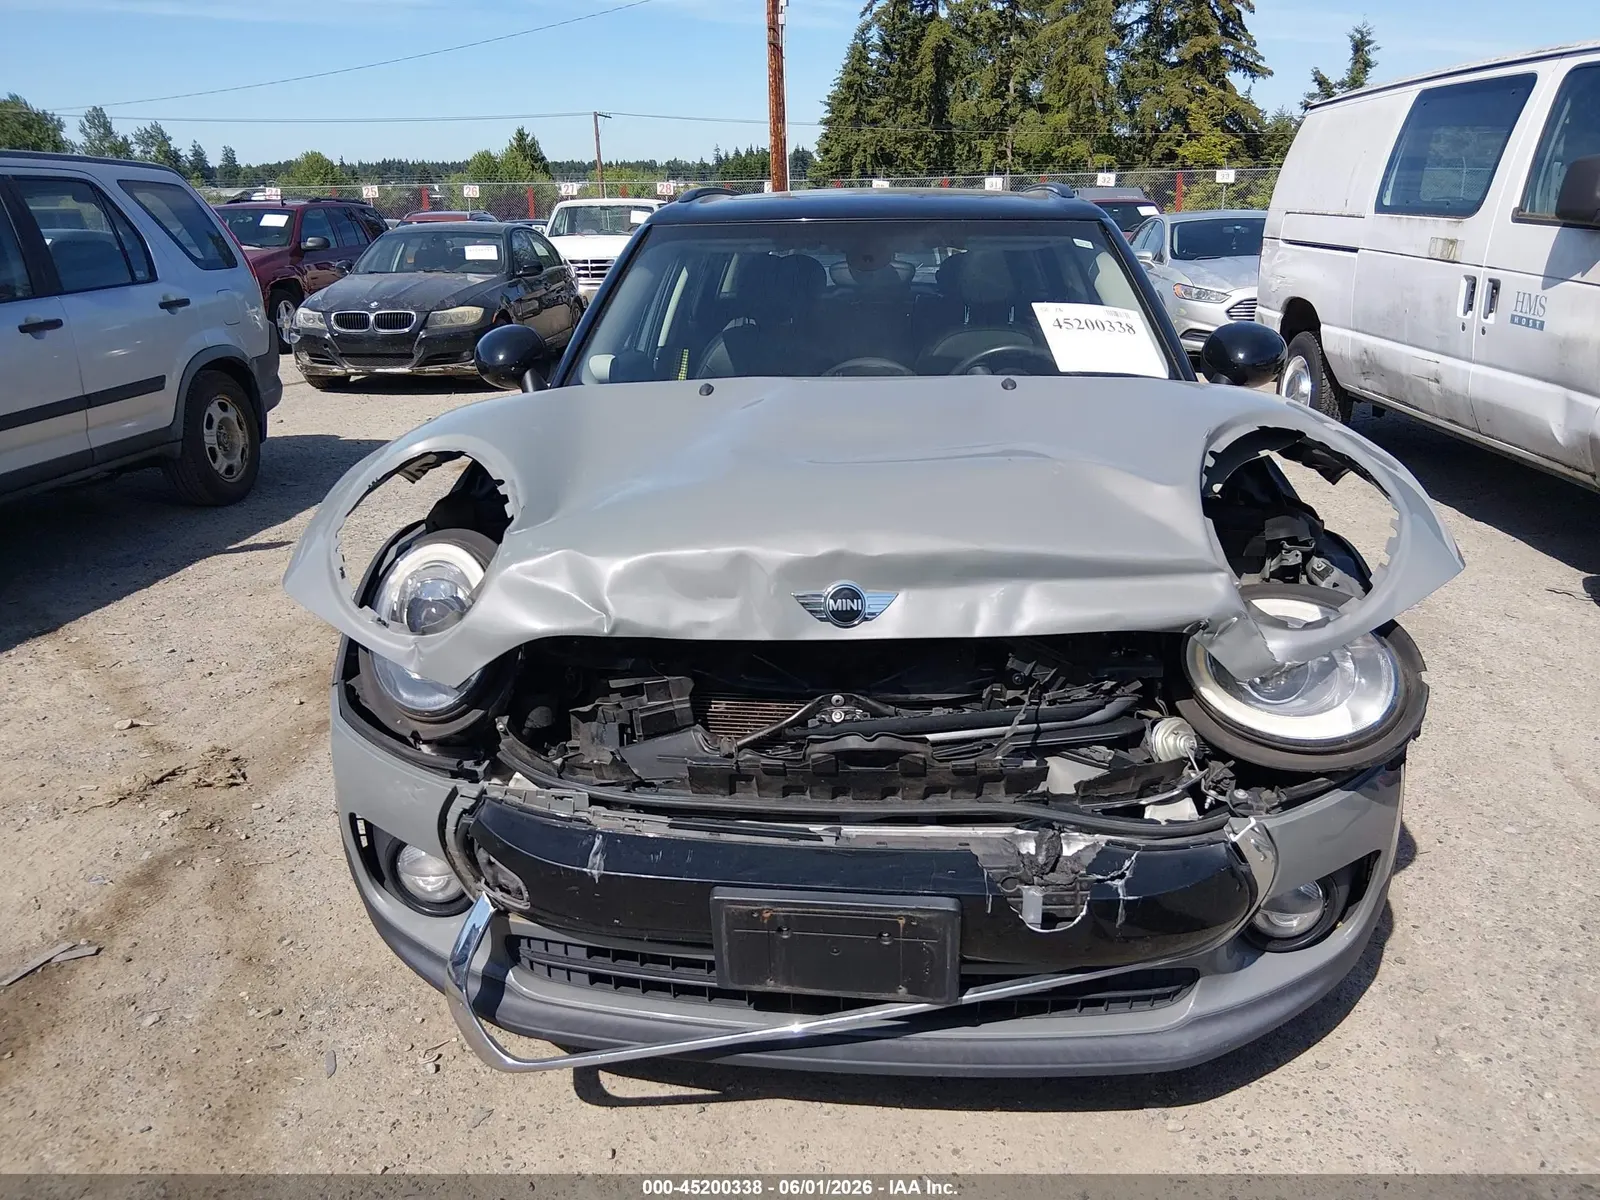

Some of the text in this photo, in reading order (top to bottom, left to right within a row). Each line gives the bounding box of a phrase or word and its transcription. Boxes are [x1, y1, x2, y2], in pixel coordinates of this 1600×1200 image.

[1101, 176, 1111, 184] 32
[364, 186, 377, 197] 25
[465, 186, 478, 197] 26
[563, 184, 576, 195] 27
[659, 183, 672, 194] 28
[1513, 290, 1548, 318] HMS
[1052, 317, 1136, 335] 45200338
[1513, 315, 1541, 329] HOST
[828, 598, 862, 611] MINI
